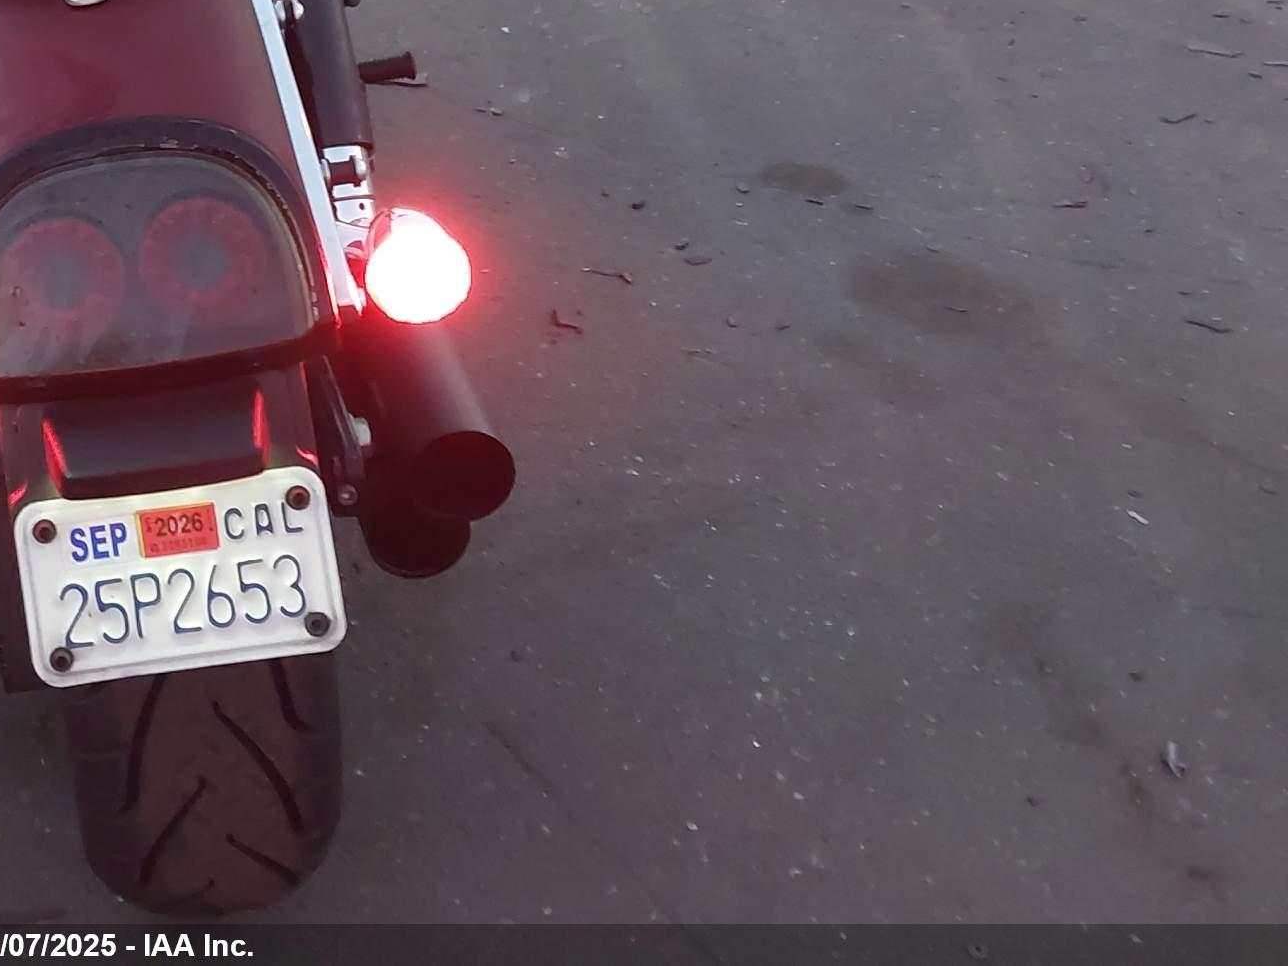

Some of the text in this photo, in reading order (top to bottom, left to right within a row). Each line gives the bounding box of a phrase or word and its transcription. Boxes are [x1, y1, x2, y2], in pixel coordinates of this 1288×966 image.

[154, 512, 203, 537] 2026
[224, 502, 304, 541] CAL
[70, 522, 128, 563] SEP
[60, 554, 307, 649] 25P2653
